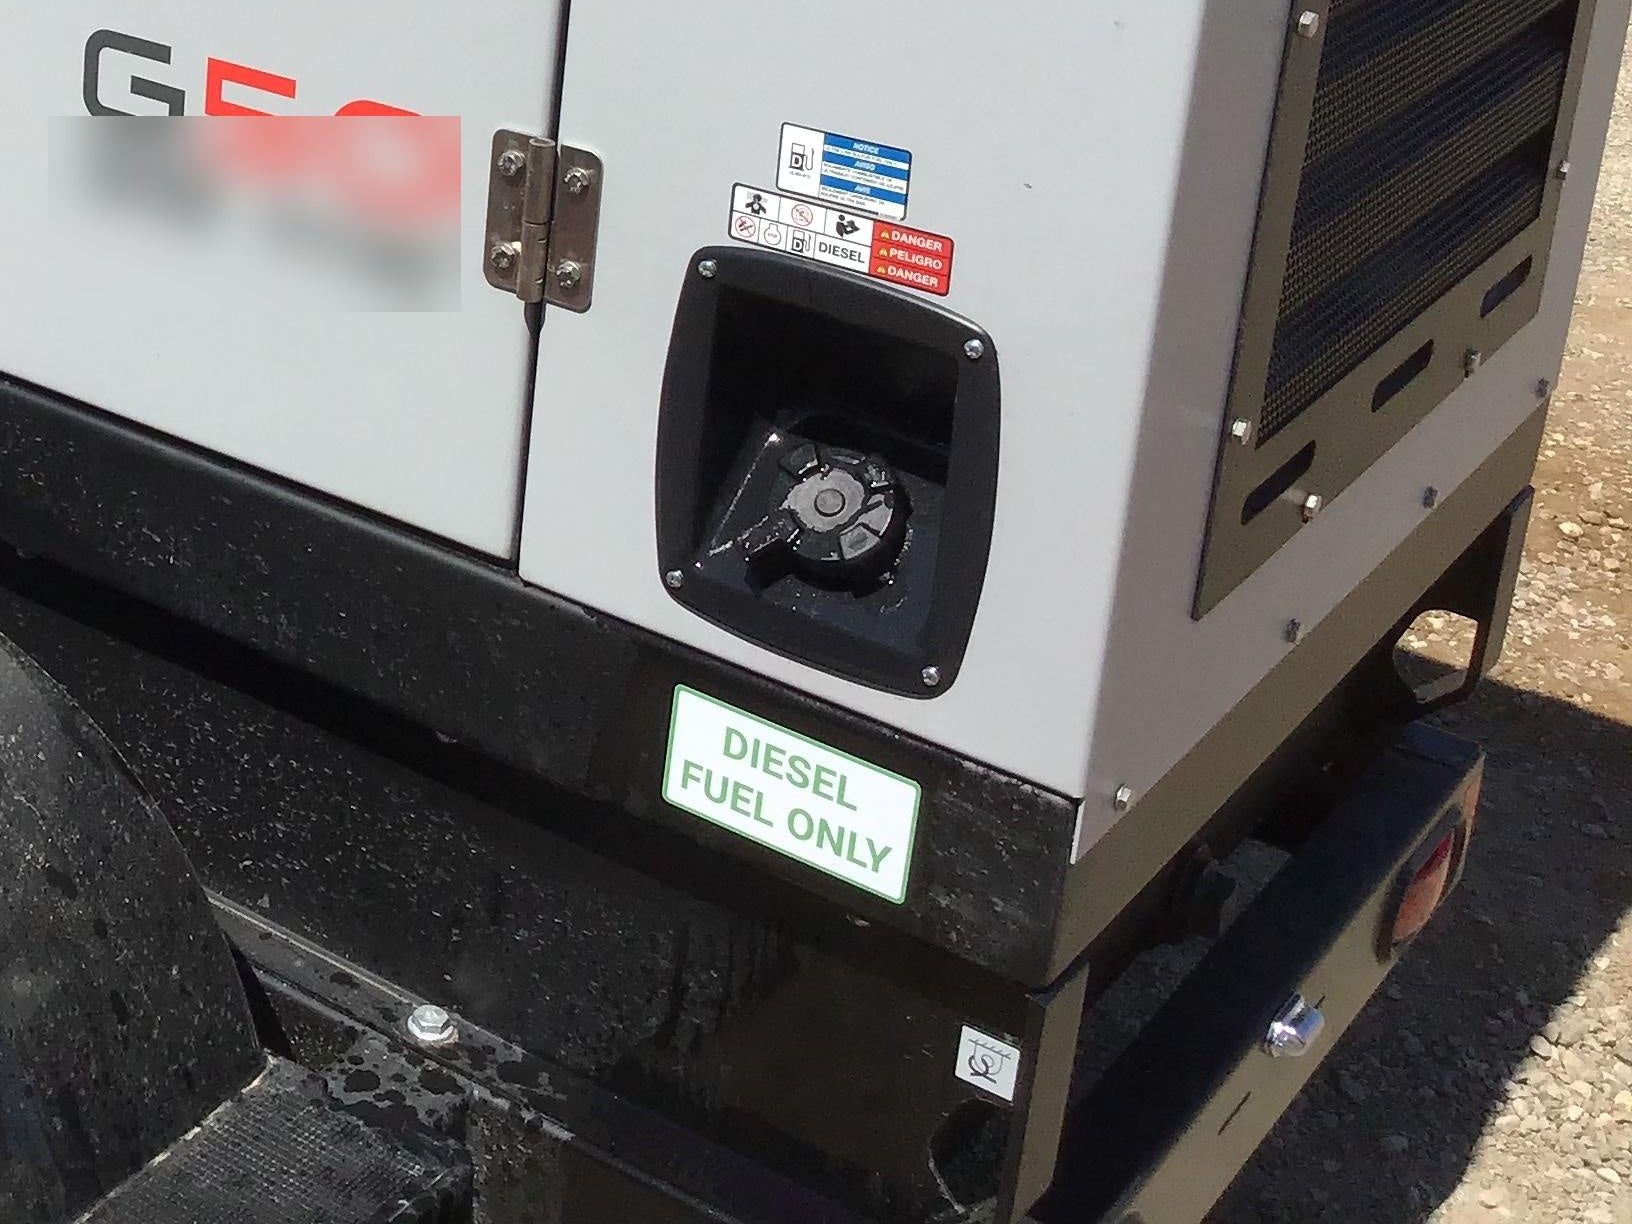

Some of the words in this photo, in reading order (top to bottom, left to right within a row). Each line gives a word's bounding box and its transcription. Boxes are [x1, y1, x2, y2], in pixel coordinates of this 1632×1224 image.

[818, 241, 866, 264] DIESEL
[891, 229, 943, 253] DANGER
[889, 247, 943, 271] PELIGRO
[887, 264, 939, 288] DANGER
[723, 726, 858, 812] DIESEL
[680, 759, 774, 828] FUEL
[787, 807, 893, 874] ONLY
